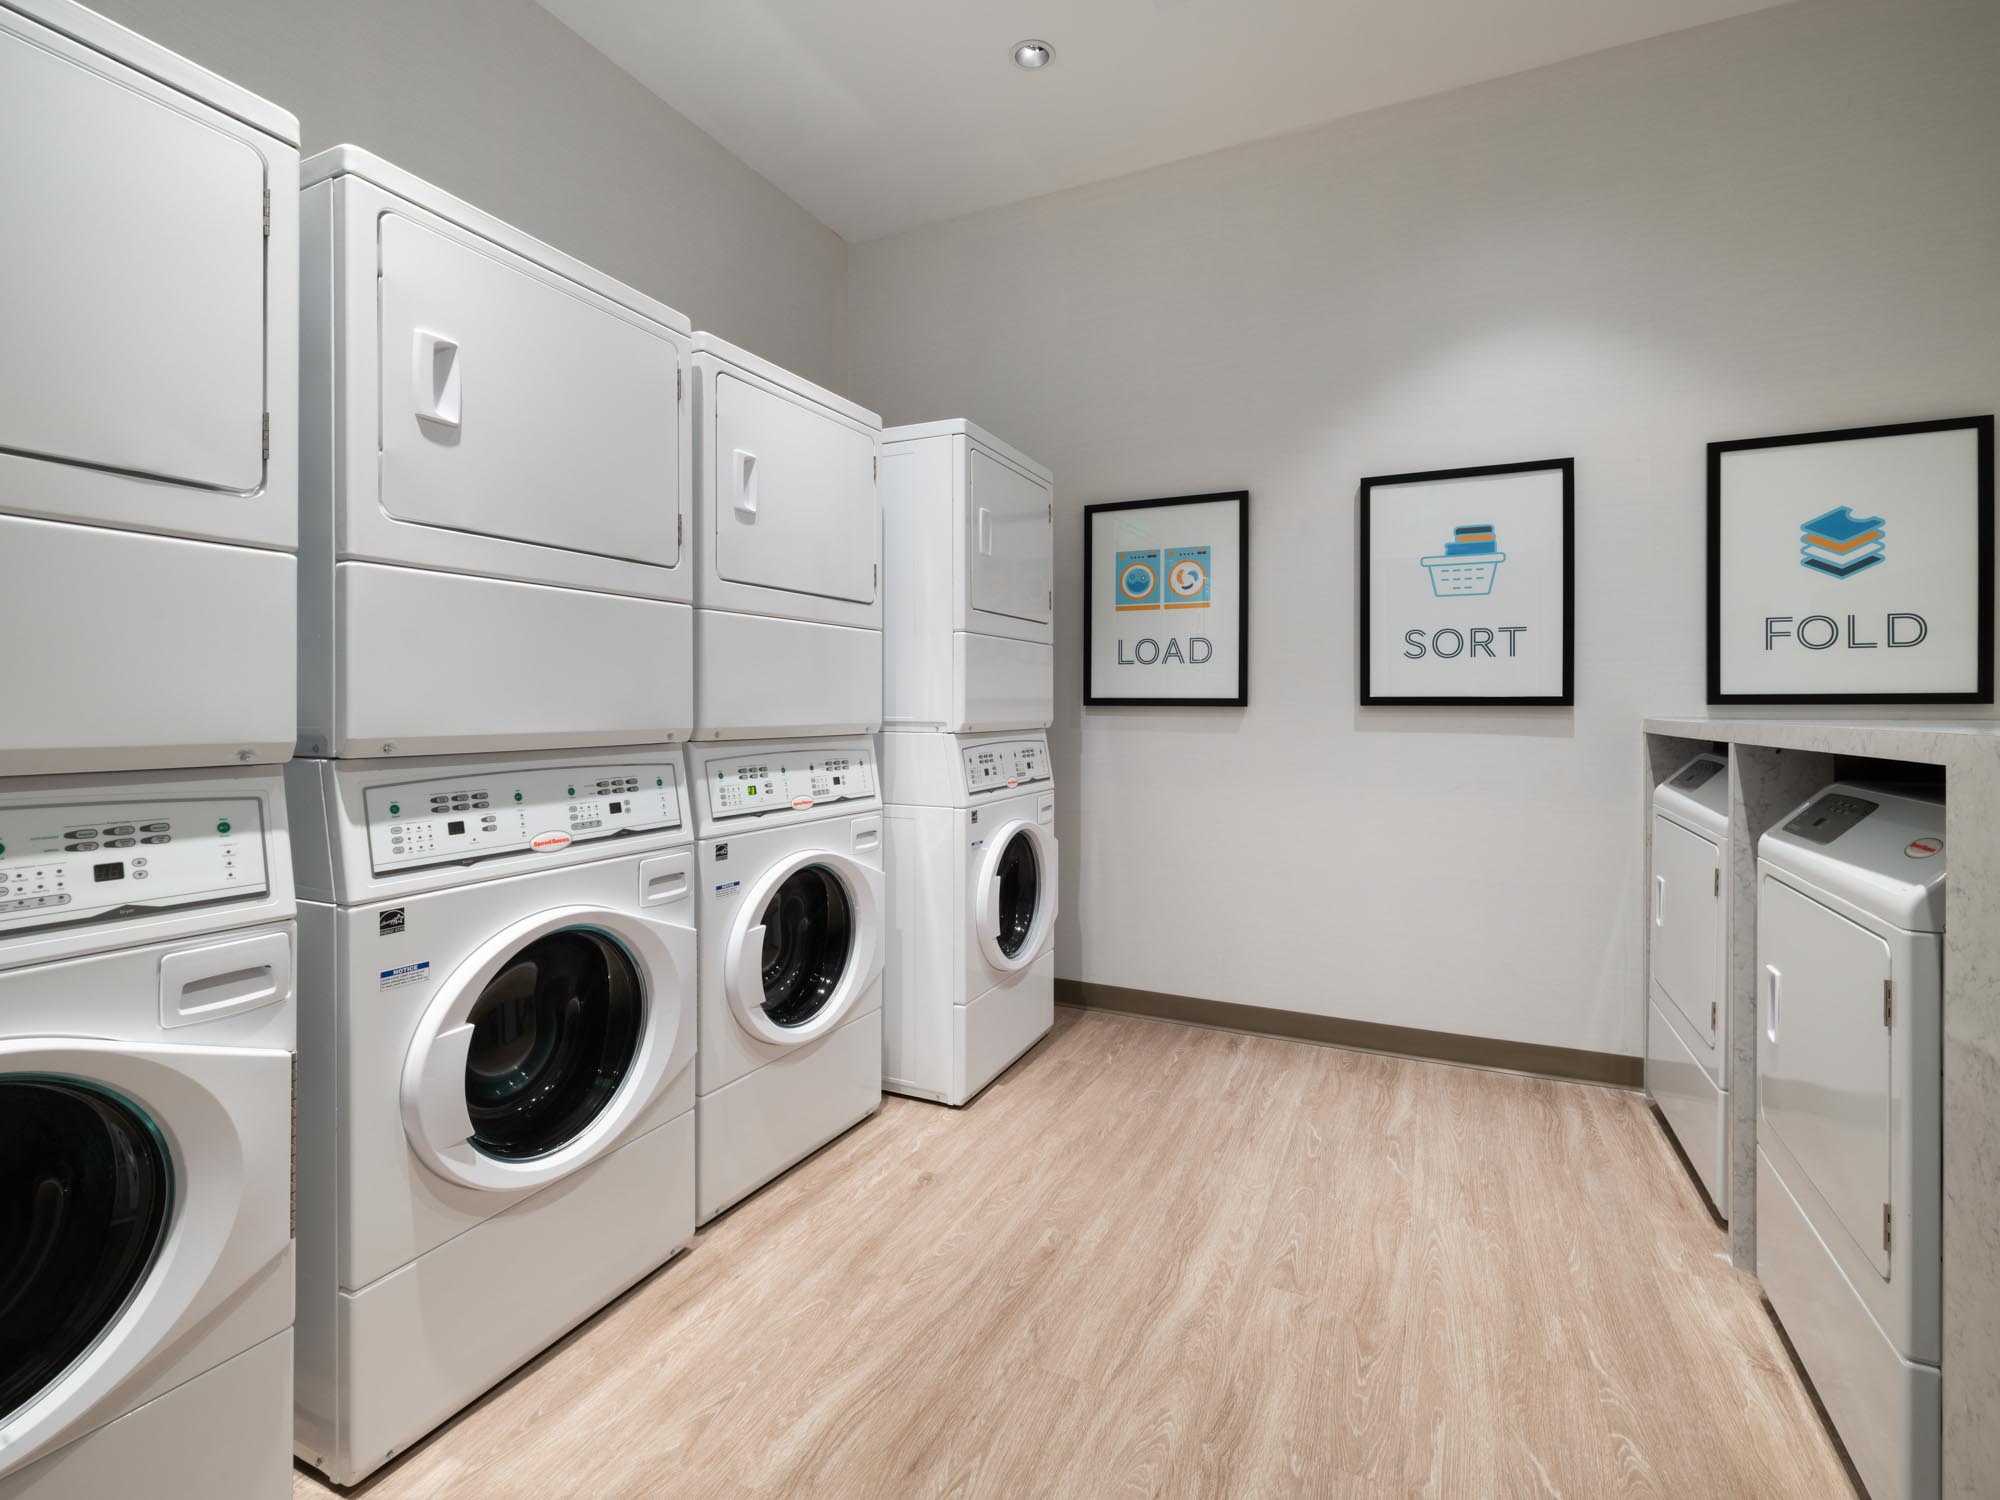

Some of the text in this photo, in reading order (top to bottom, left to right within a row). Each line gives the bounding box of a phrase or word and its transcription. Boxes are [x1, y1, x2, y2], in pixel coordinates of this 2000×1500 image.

[1404, 627, 1527, 659] SORT
[1765, 613, 1928, 650] FOLD
[1118, 638, 1212, 665] LOAD
[393, 965, 418, 975] NOTICE
